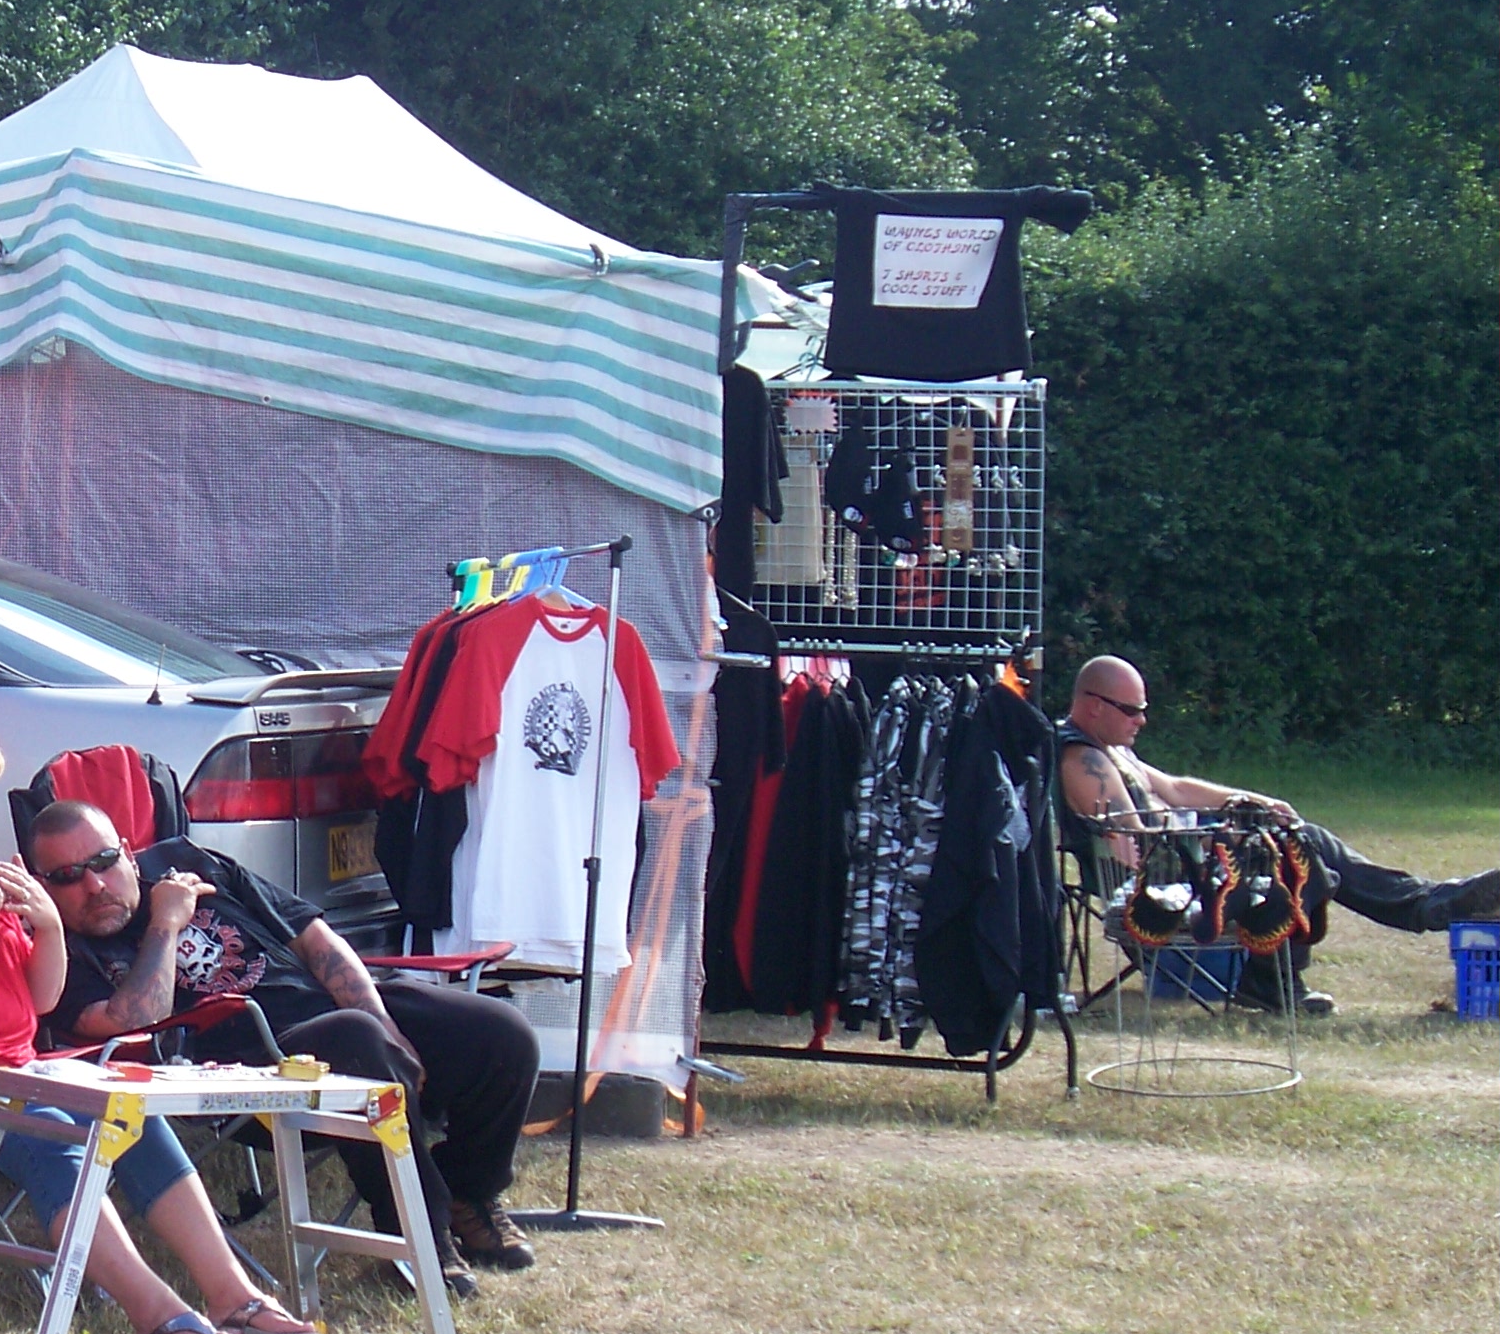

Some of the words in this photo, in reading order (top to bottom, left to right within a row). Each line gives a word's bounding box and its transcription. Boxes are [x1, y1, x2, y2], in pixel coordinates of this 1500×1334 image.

[884, 226, 942, 239] WAYNES
[946, 229, 997, 241] WORLD
[883, 241, 902, 251] OF
[906, 241, 981, 255] CLOTHING
[882, 269, 891, 280] T
[895, 270, 949, 283] SHIRTS
[881, 283, 918, 295] COOL
[922, 284, 967, 296] STUFF
[177, 939, 197, 960] 13
